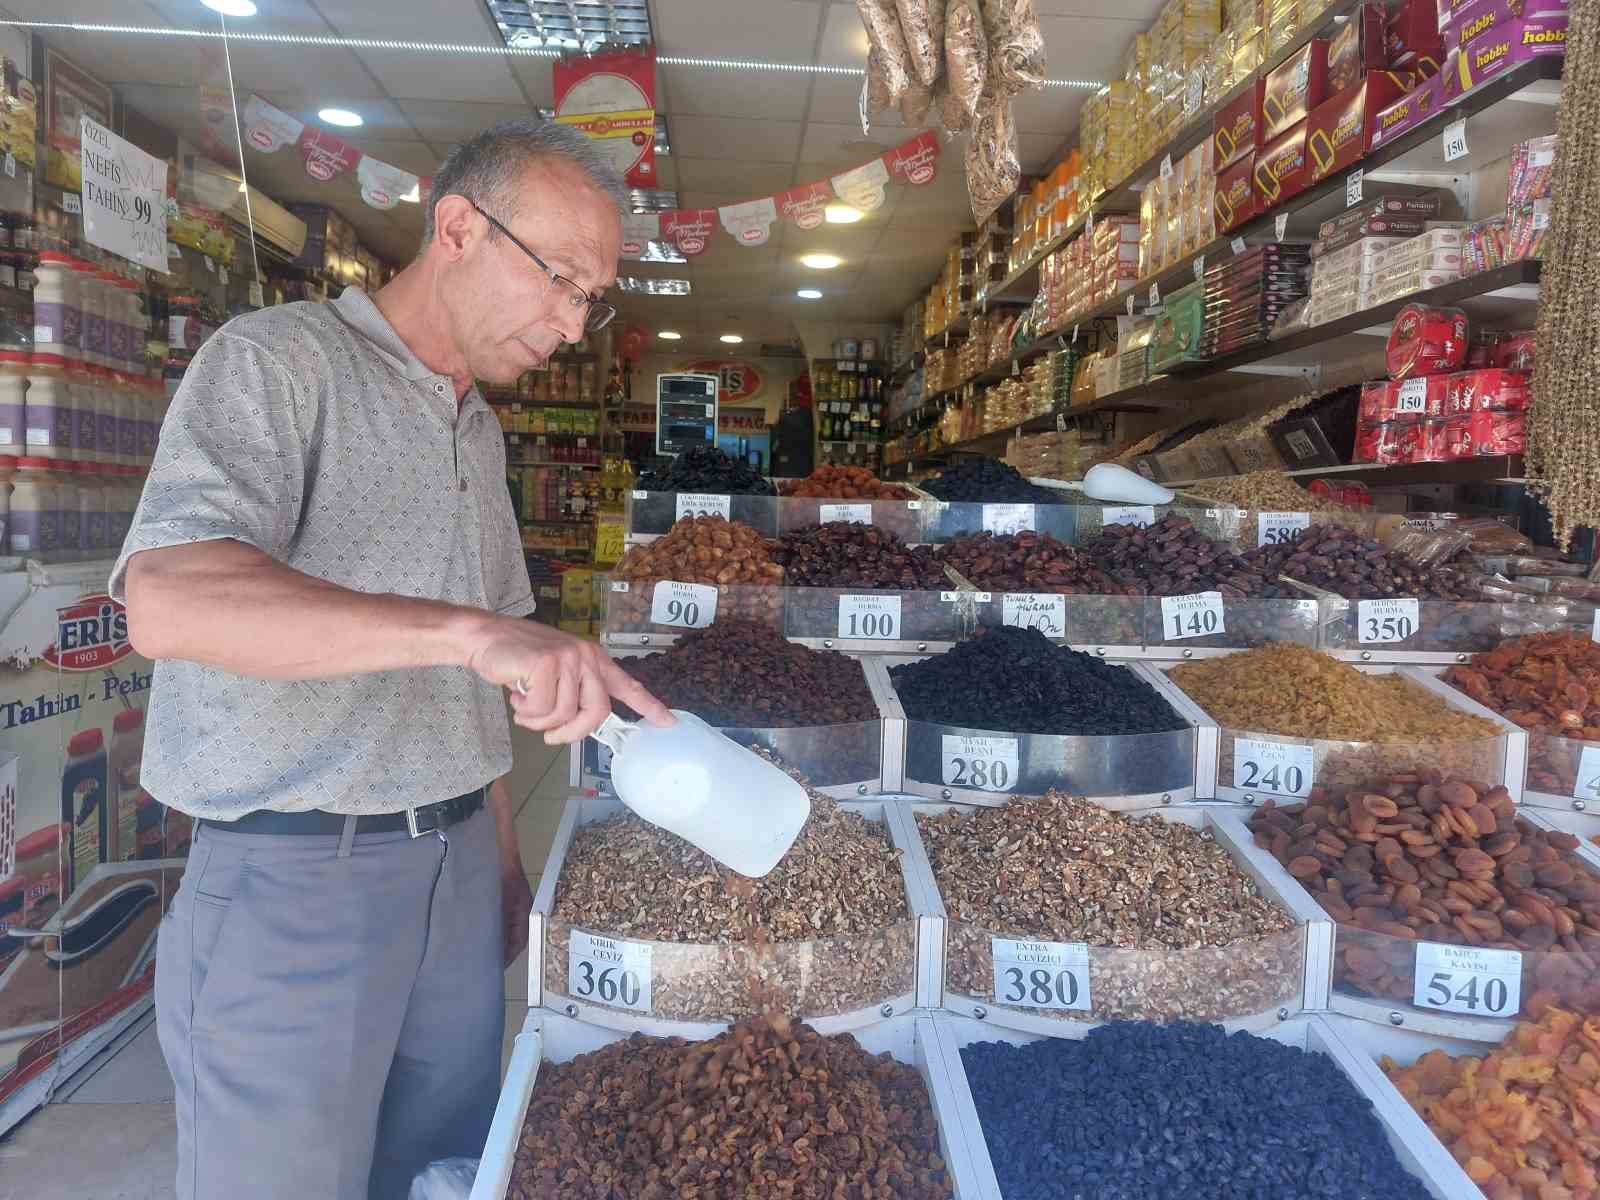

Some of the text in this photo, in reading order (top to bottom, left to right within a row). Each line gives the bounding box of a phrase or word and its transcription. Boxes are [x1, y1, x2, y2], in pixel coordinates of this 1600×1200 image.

[1447, 139, 1464, 156] 150
[134, 196, 152, 225] 99
[1400, 396, 1421, 410] 150
[665, 599, 699, 626] 90
[848, 612, 893, 637] 100
[1173, 609, 1217, 637] 140
[1365, 616, 1411, 641] 350
[74, 652, 99, 665] 1903
[0, 692, 81, 730] Tahin
[951, 757, 1008, 789] 280
[1241, 760, 1303, 794] 240
[576, 960, 641, 1006] 360
[1004, 966, 1079, 1006] 380
[1426, 972, 1508, 1013] 540
